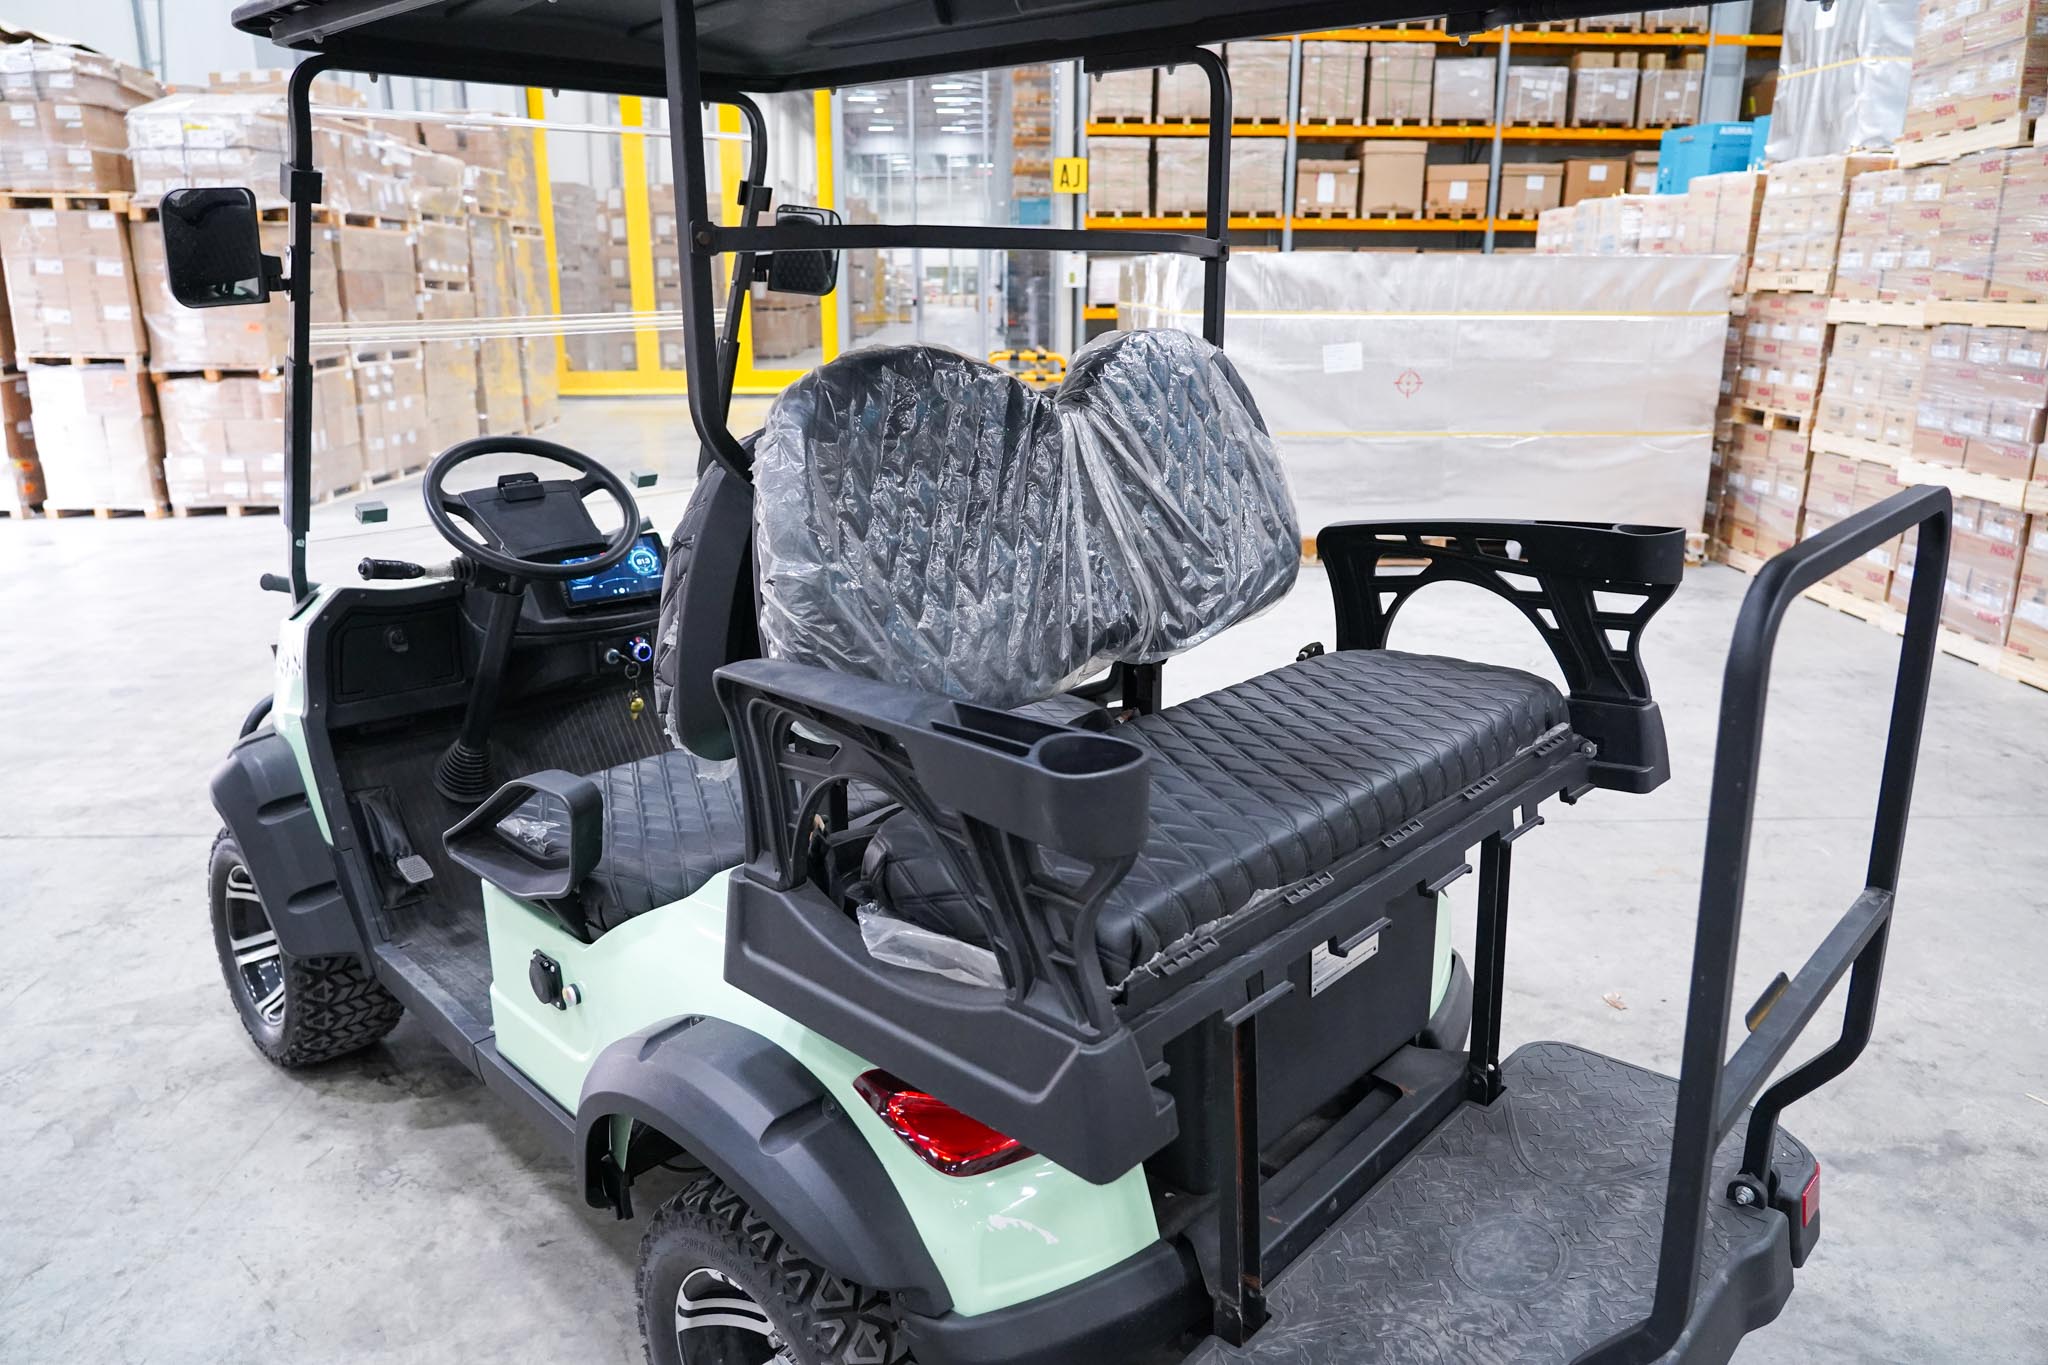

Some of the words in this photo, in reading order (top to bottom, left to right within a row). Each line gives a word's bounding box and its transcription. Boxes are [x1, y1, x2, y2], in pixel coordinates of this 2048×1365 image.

[1059, 163, 1081, 188] AJ
[1990, 543, 2015, 561] NSK
[1976, 610, 2001, 626] NSK
